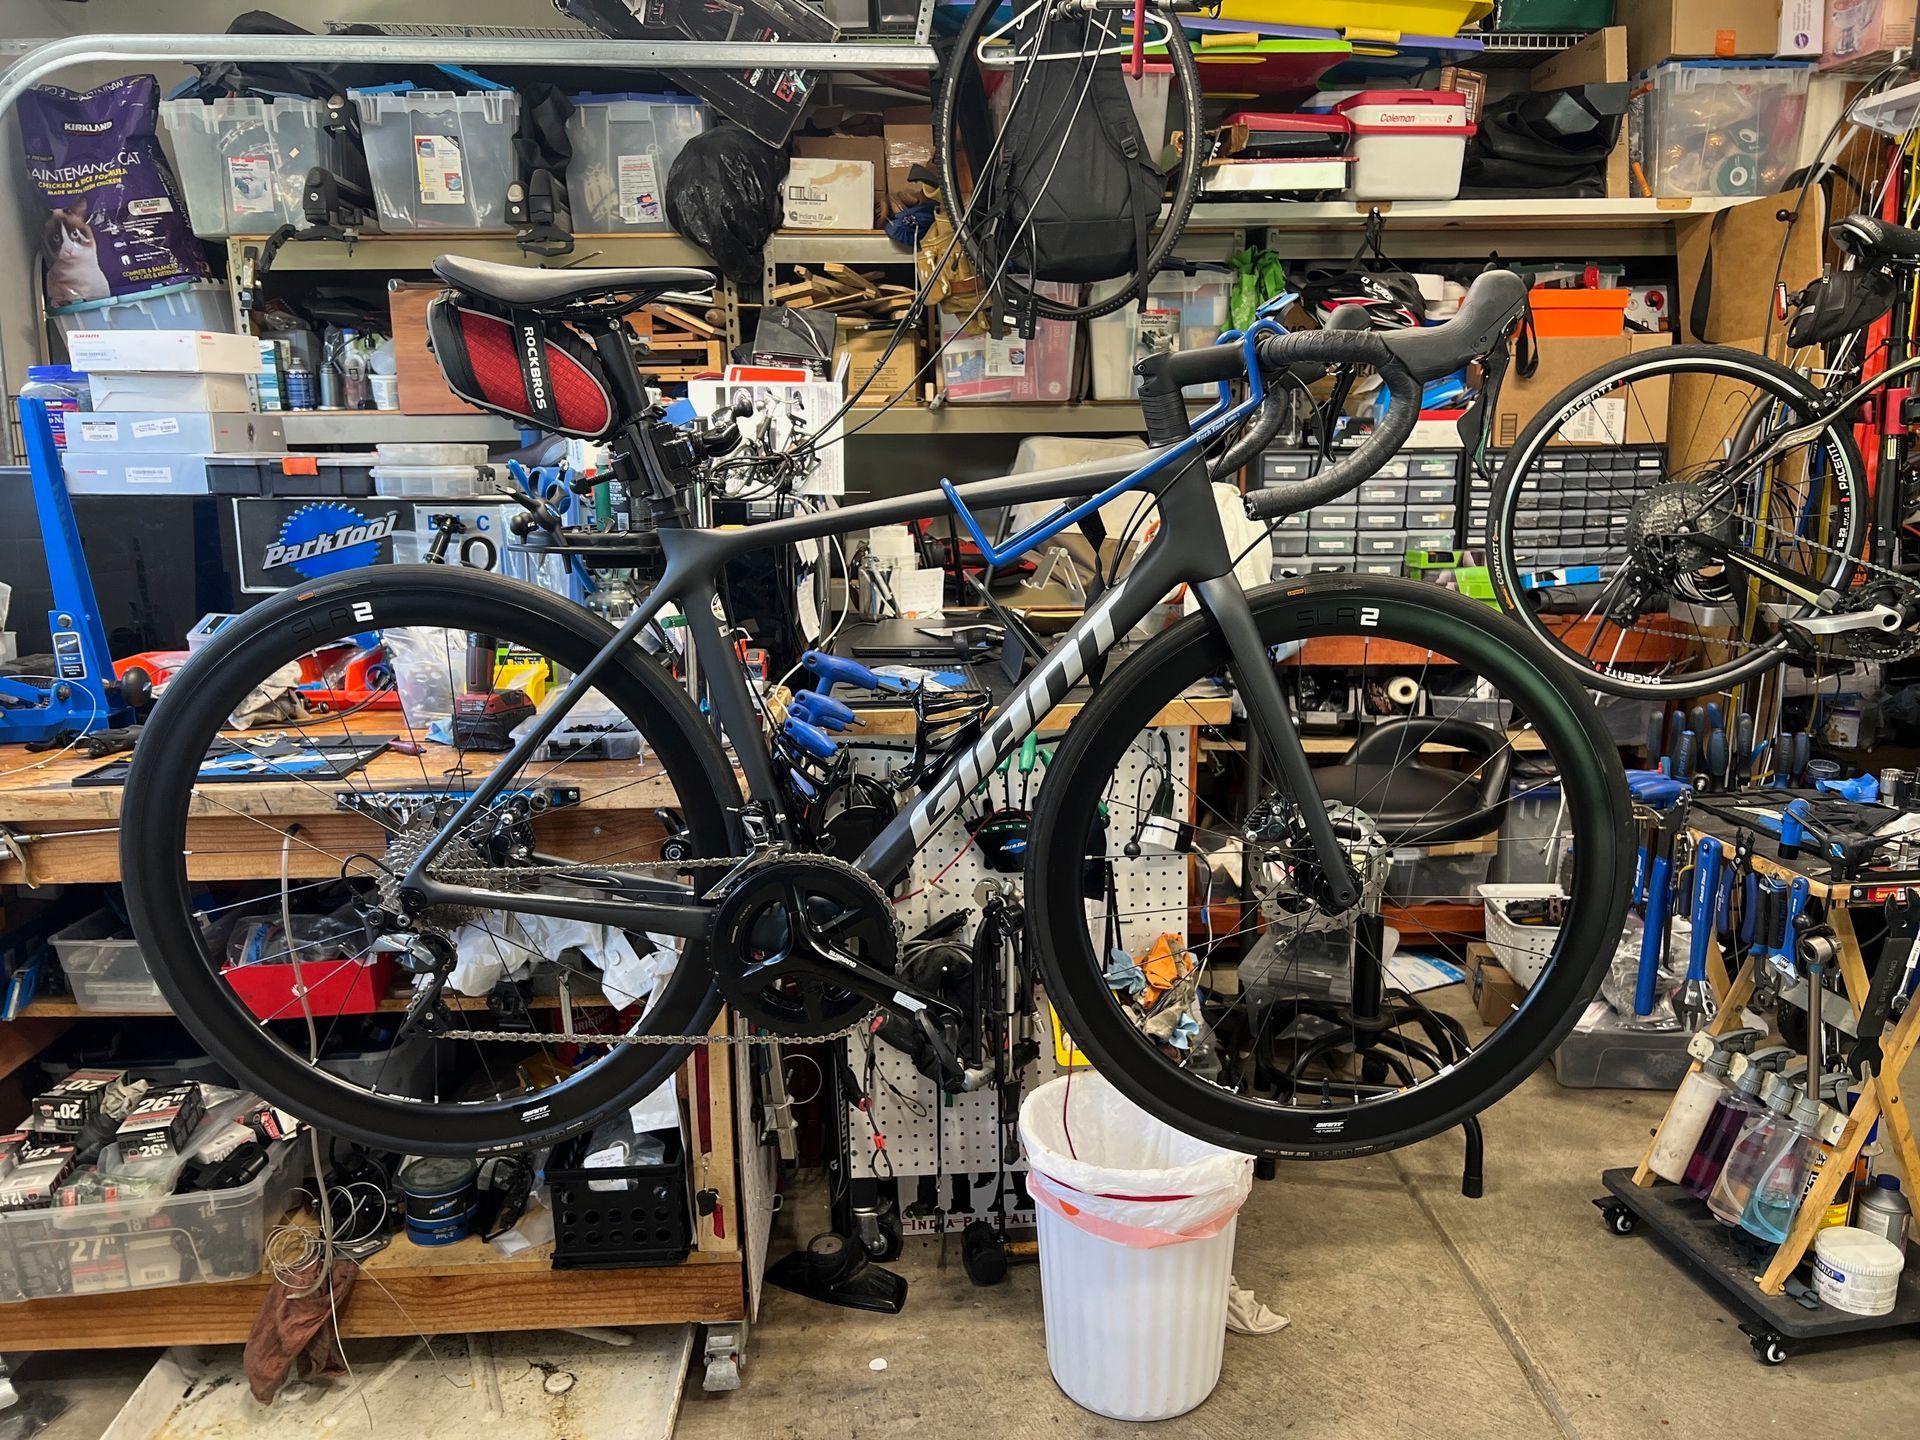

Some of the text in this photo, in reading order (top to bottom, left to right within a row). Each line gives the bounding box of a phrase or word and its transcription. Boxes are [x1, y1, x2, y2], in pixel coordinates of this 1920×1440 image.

[64, 121, 113, 132] KIRKLAND
[1380, 113, 1415, 122] Coleman
[117, 151, 141, 165] CAT
[38, 181, 72, 189] CHICKEN
[74, 180, 80, 189] &
[96, 177, 122, 188] CHICKEN
[122, 267, 146, 277] COMPLETE
[523, 326, 548, 410] ROCKBROS
[1561, 382, 1613, 422] PACENTI
[1826, 442, 1849, 490] PACENTI
[1836, 527, 1847, 548] SL23
[1492, 543, 1504, 585] CONTACT
[291, 601, 374, 642] SLR 2
[1296, 607, 1380, 629] SLR 2
[1604, 666, 1661, 685] PACENTI
[909, 574, 1137, 849] GIANT
[828, 949, 857, 969] SHIMANO
[54, 1103, 81, 1120] 20"
[133, 1093, 186, 1115] 26"
[522, 1105, 549, 1117] GIANT
[139, 1143, 168, 1158] 26"
[127, 1217, 147, 1233] 18"
[911, 1219, 955, 1231] INDA
[69, 1237, 116, 1263] 27"
